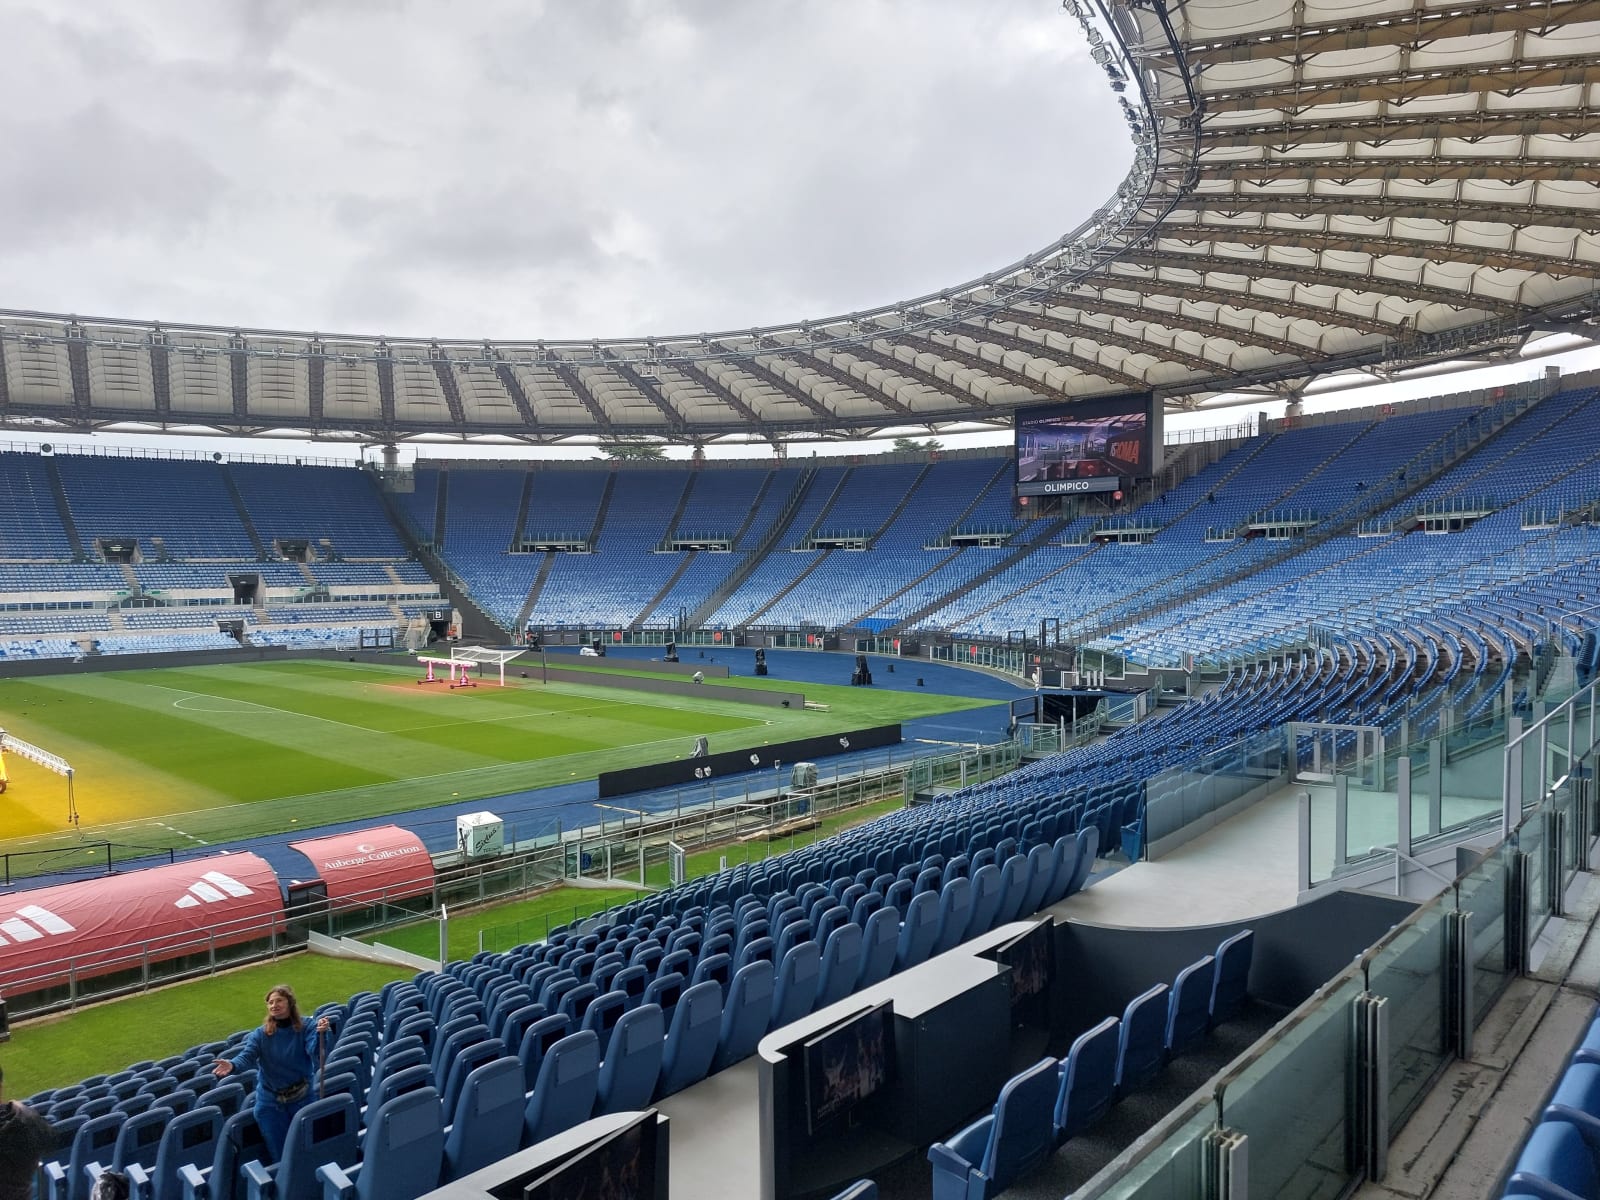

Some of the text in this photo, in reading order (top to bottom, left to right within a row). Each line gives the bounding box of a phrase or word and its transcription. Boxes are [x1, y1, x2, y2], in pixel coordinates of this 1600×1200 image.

[1044, 481, 1089, 492] OLIMPICO
[435, 611, 442, 619] B
[324, 845, 420, 870] Auberge Collection
